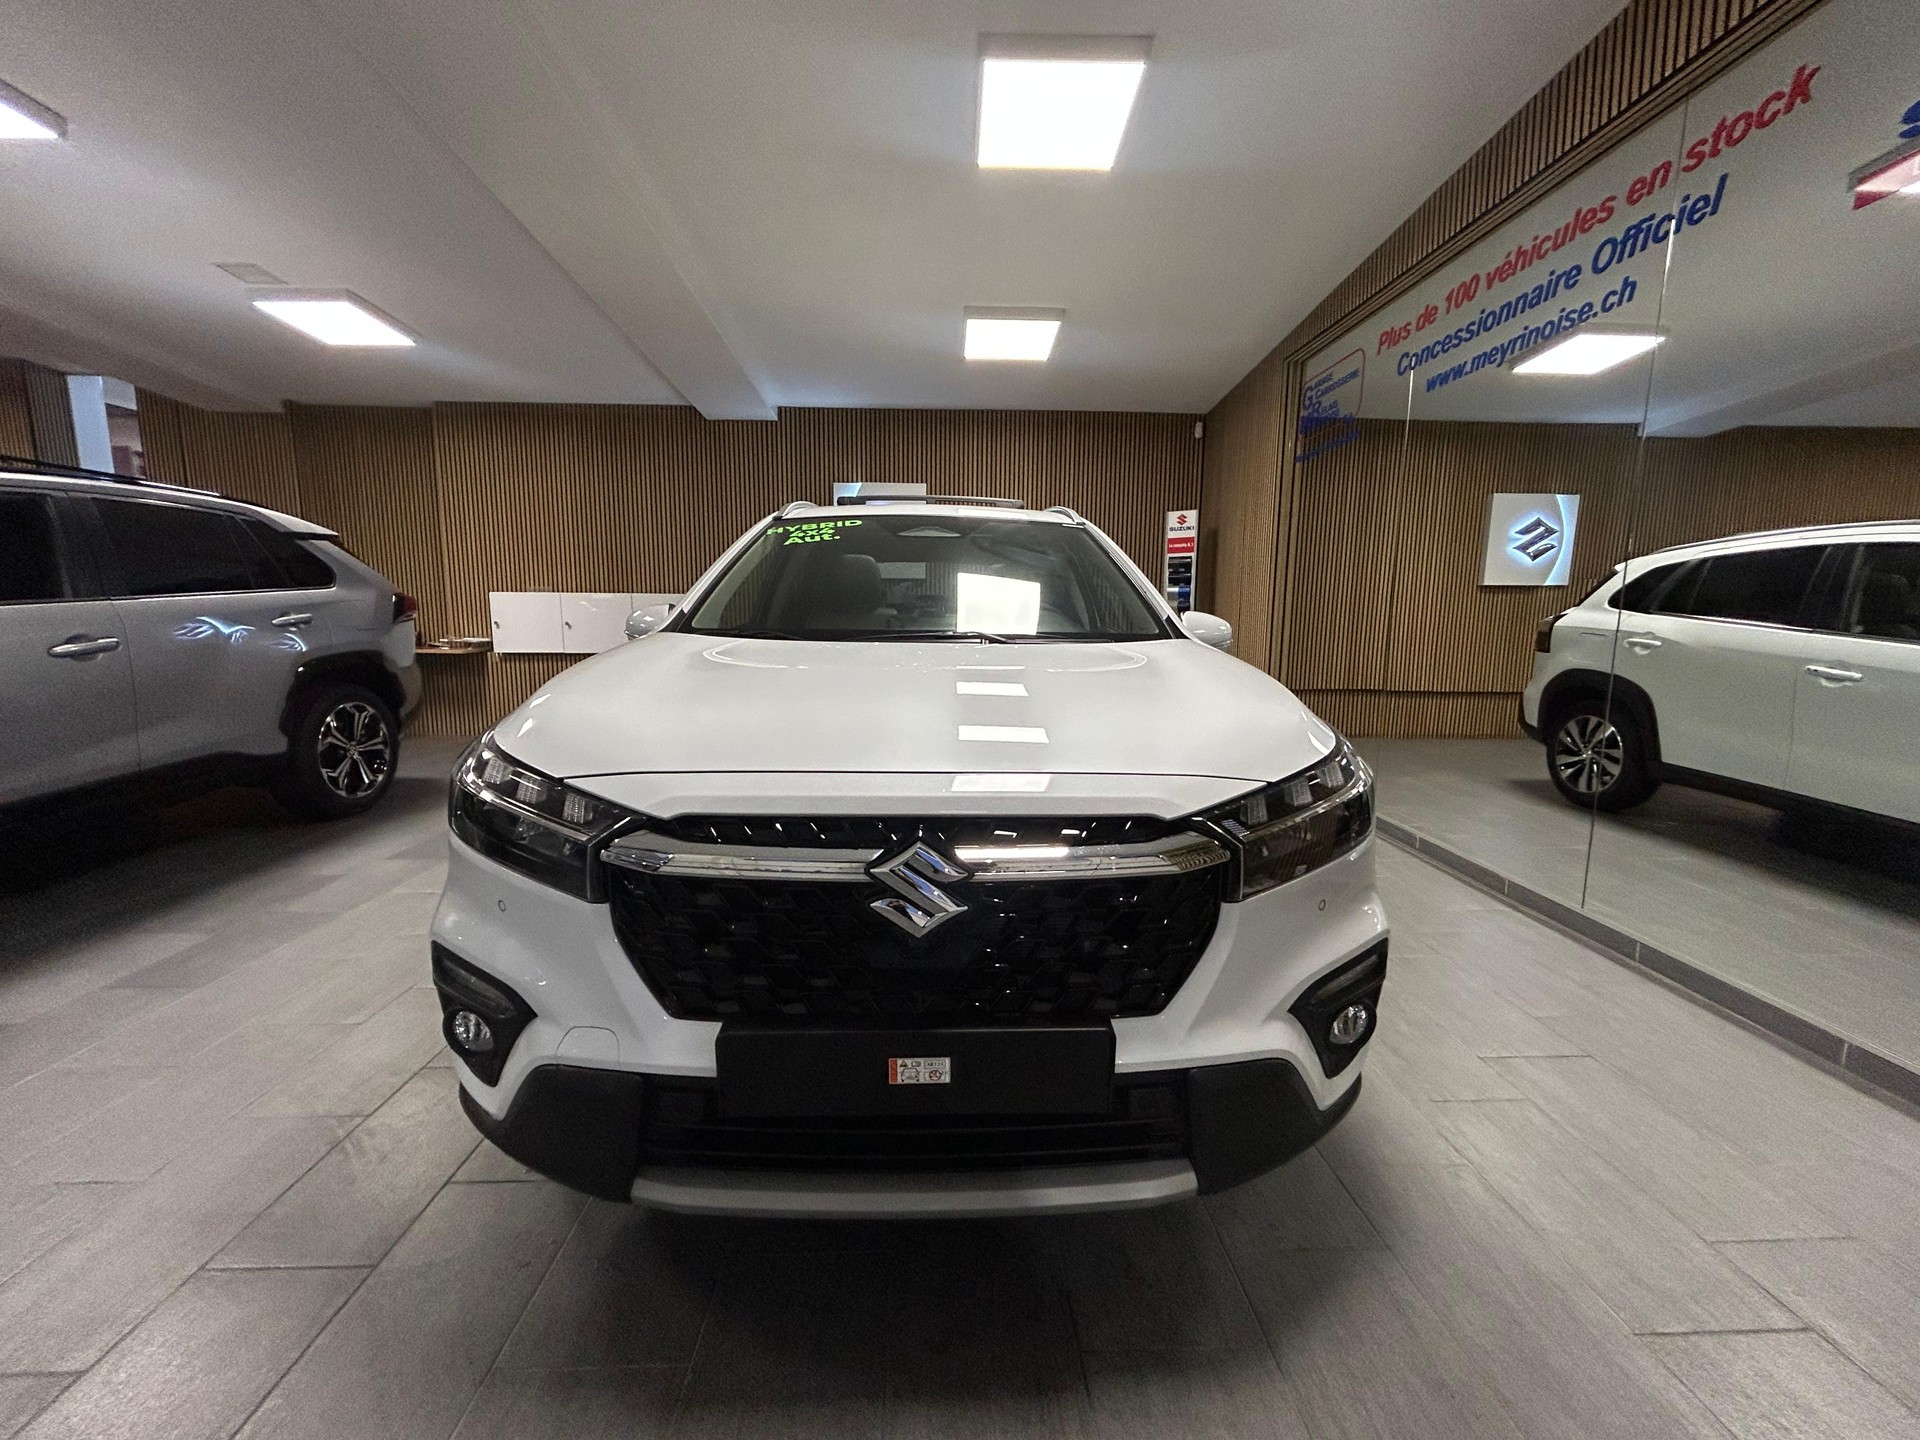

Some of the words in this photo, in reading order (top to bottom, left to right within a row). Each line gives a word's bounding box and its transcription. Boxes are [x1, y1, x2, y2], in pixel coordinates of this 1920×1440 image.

[1377, 321, 1412, 356] Plus
[1415, 303, 1439, 332] de
[1445, 273, 1480, 314] 100
[1486, 195, 1617, 290] véhicules
[1626, 160, 1672, 206] en
[1681, 63, 1822, 173] stock
[1397, 264, 1582, 376] Concessionnaire
[1591, 172, 1728, 275] Officiel
[1426, 276, 1638, 392] www.meyrinoise.ch
[766, 519, 863, 535] HYBRID
[783, 533, 841, 546] Aut.
[789, 527, 836, 537] 4x4
